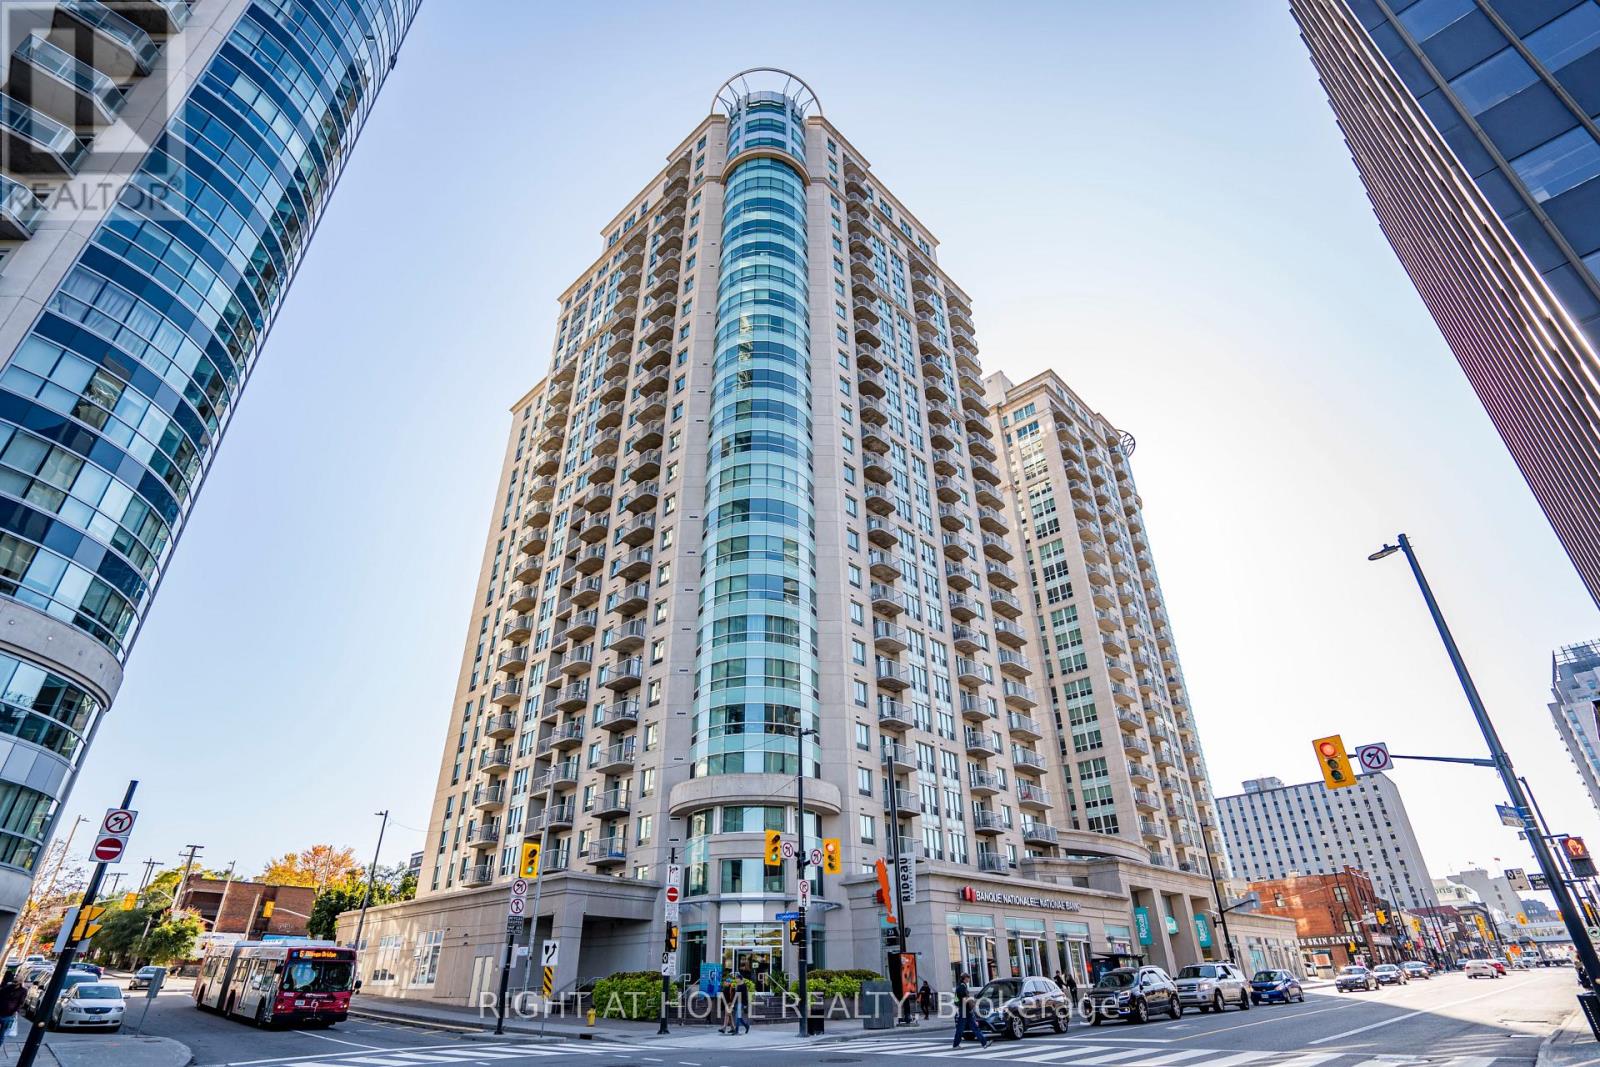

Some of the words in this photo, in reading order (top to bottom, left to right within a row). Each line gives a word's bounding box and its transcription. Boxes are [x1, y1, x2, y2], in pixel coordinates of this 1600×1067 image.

[976, 890, 1002, 903] BANQUE
[1136, 914, 1147, 938] Rexall
[1195, 920, 1207, 942] Rexall
[1307, 937, 1328, 946] SKIN
